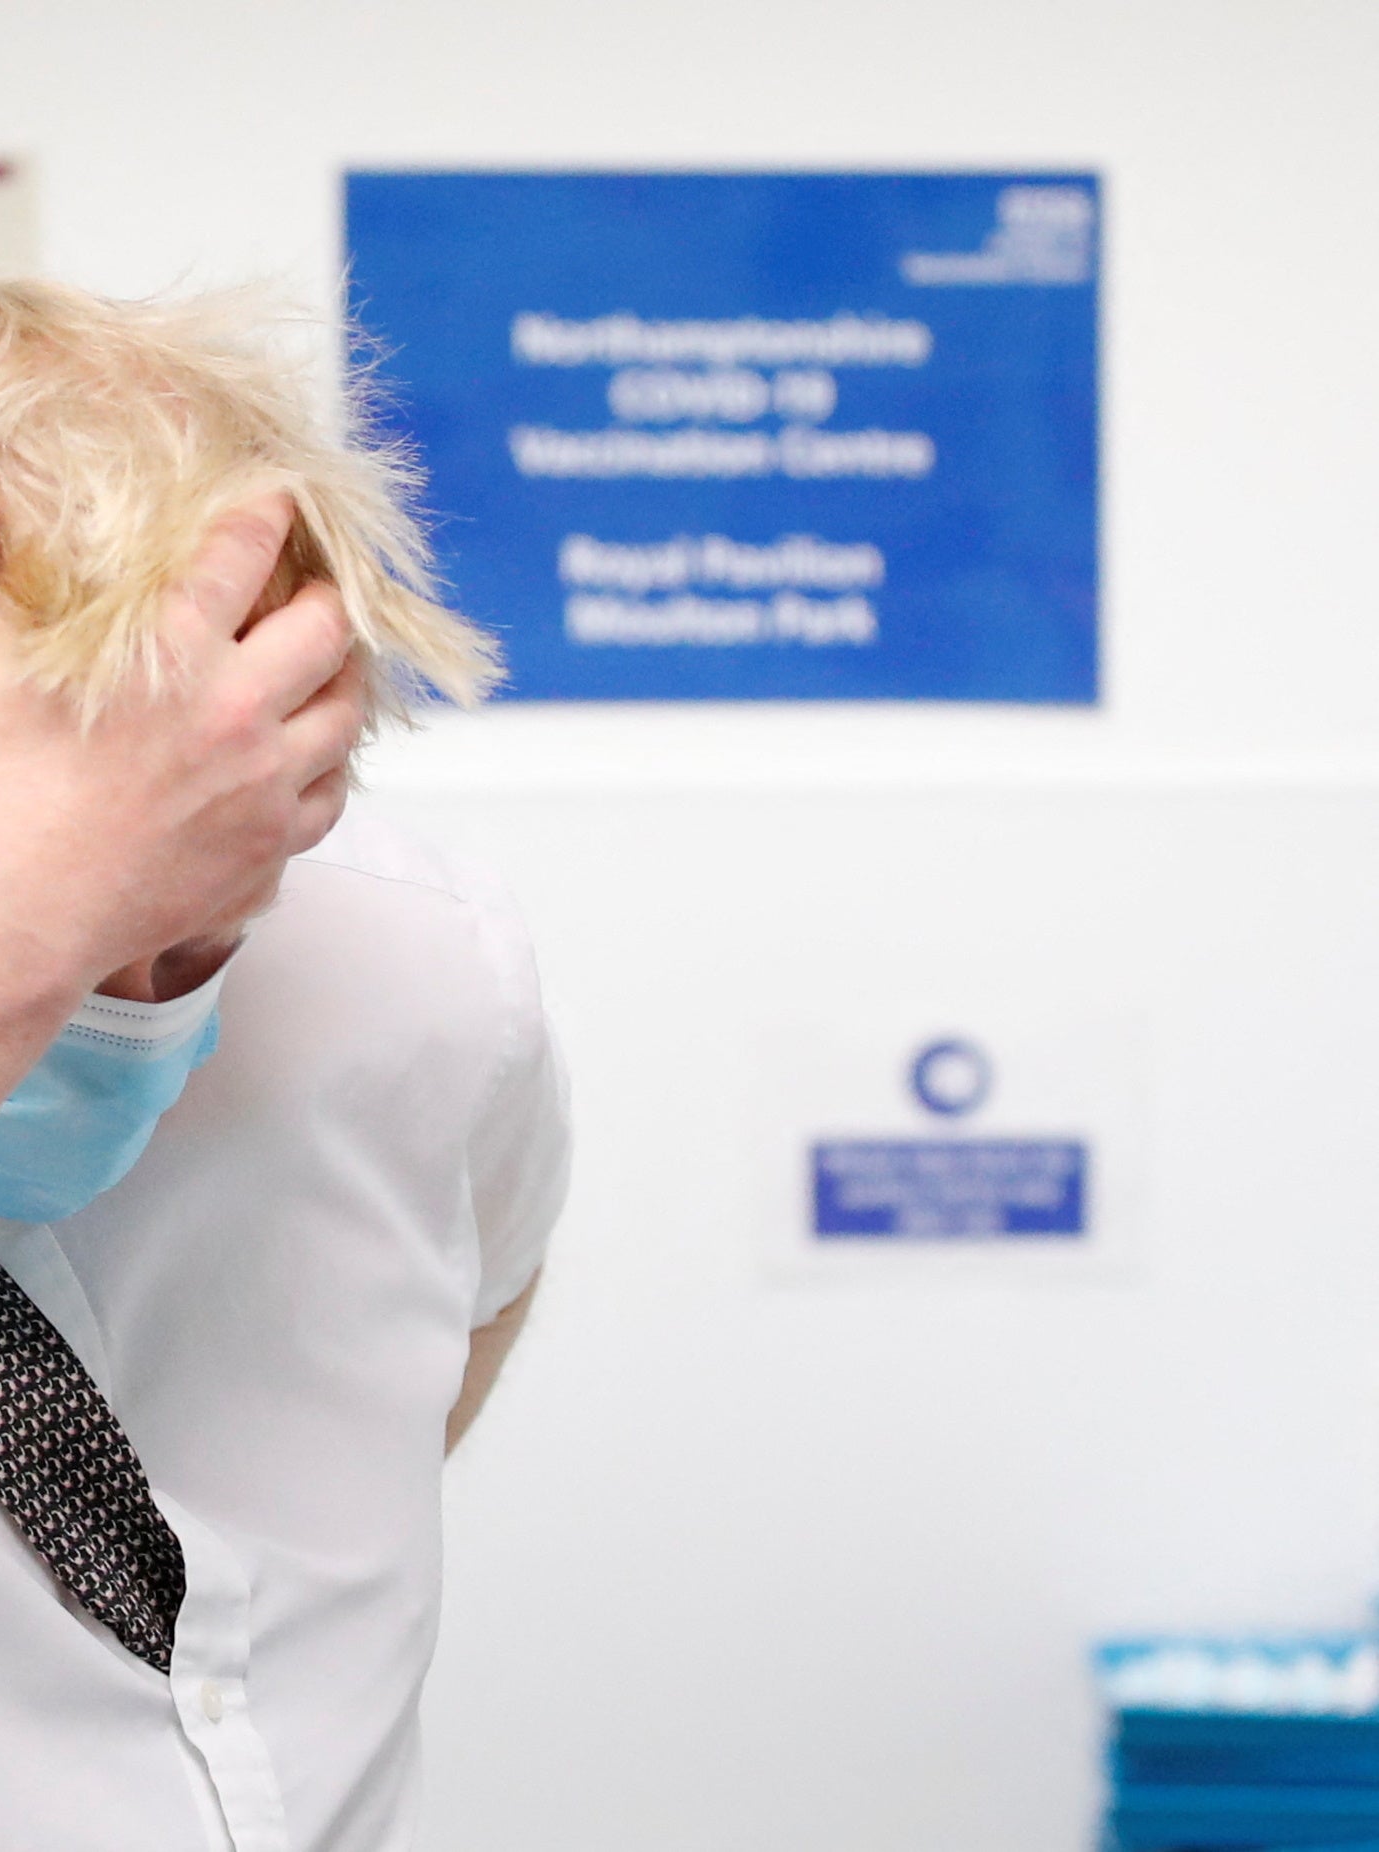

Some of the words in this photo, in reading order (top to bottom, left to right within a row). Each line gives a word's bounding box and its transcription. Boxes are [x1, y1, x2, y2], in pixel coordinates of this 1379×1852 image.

[511, 427, 770, 477] Vaccination
[778, 427, 933, 477] Centre
[560, 536, 691, 593] Royal
[700, 536, 882, 588] Pavilion
[772, 595, 877, 645] Park
